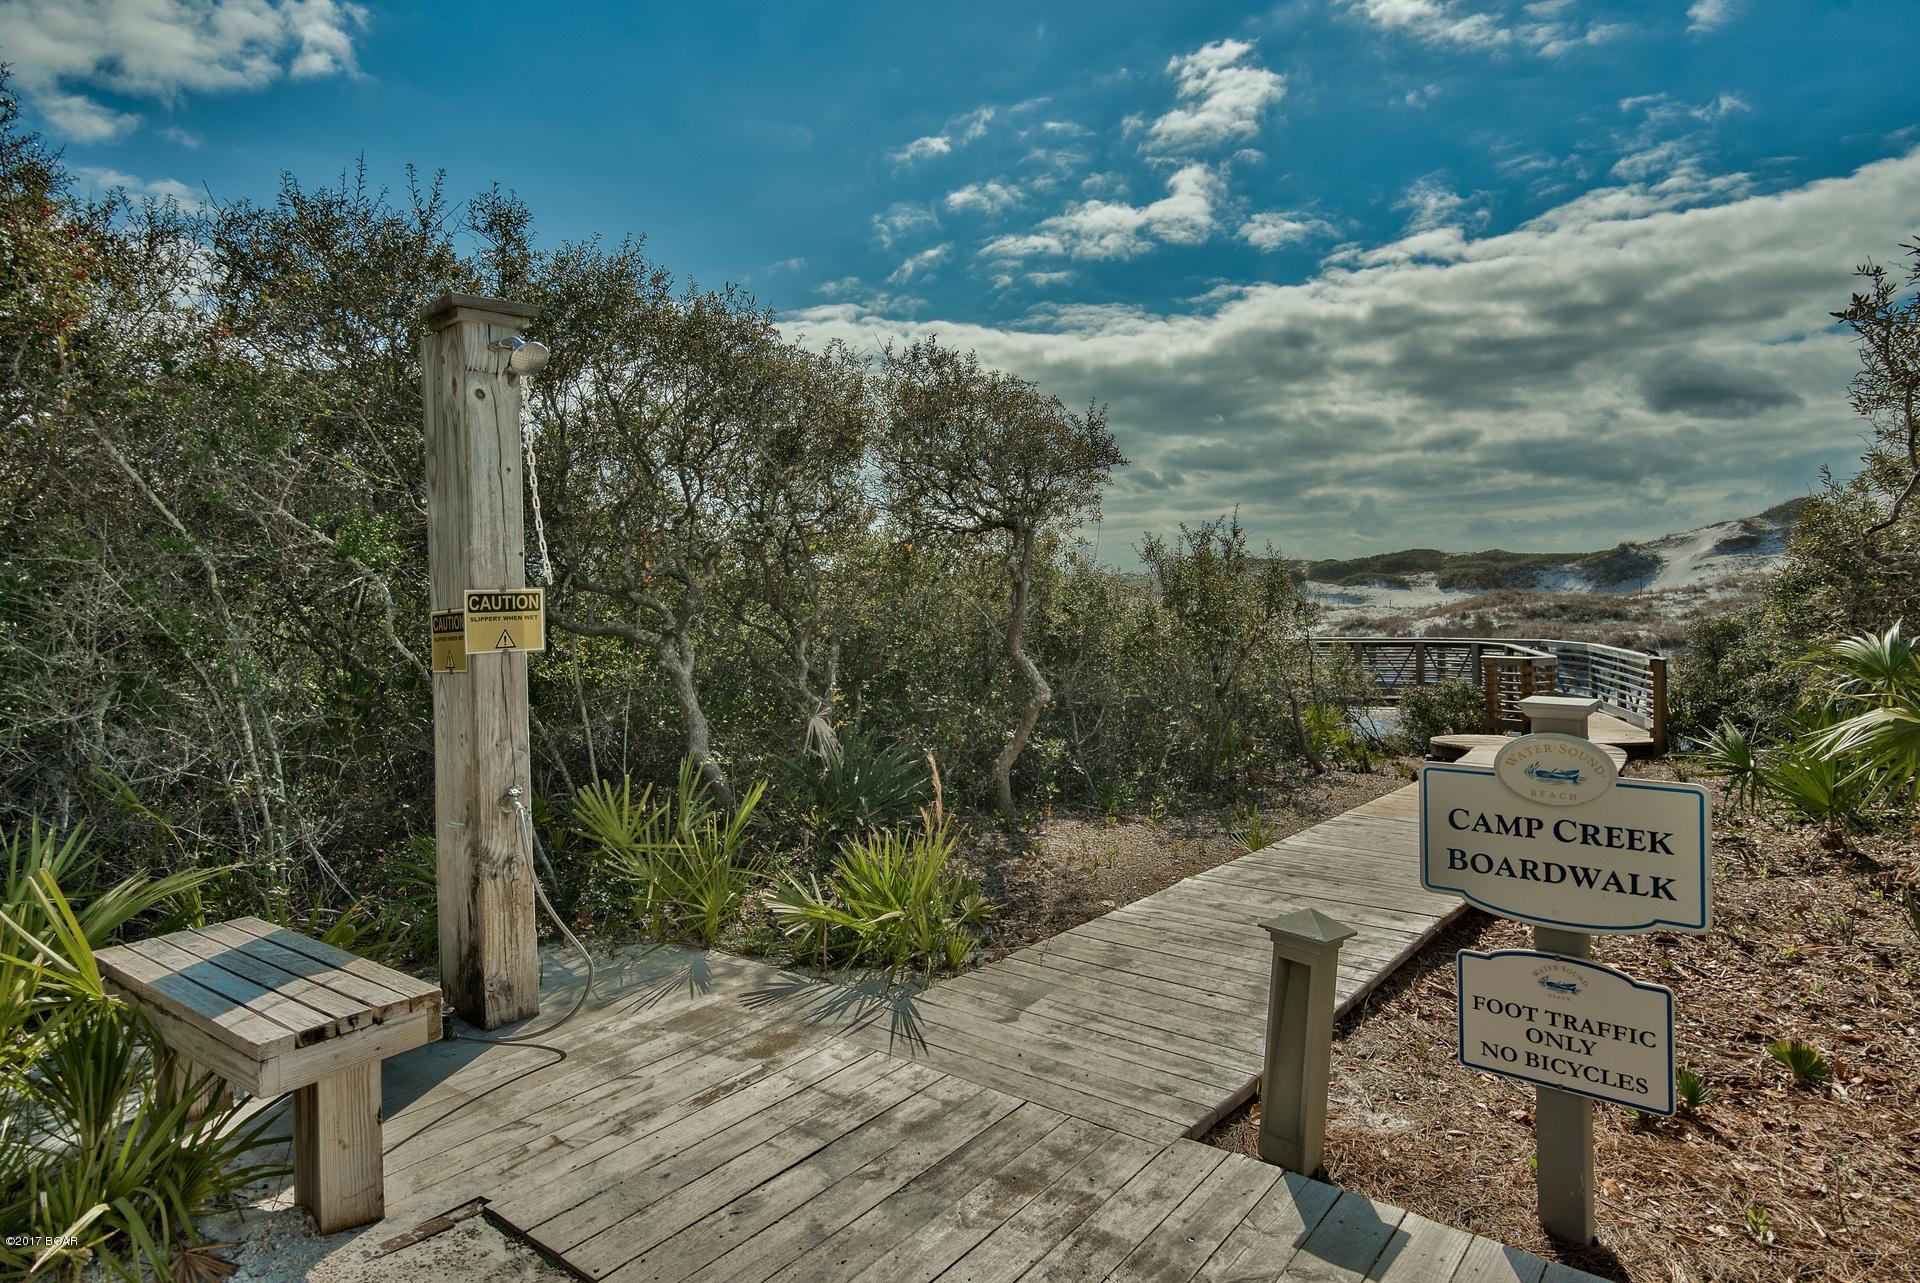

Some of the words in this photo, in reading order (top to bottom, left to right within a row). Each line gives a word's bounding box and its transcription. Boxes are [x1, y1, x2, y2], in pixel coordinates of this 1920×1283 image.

[468, 594, 539, 610] CAUTION
[1530, 789, 1577, 800] BEACH
[1448, 808, 1544, 839] CAMP
[1553, 820, 1675, 856] CREEK
[1446, 848, 1678, 901] BOARDWALK
[1472, 995, 1538, 1022] FOOT
[1545, 1010, 1656, 1048] TRAFFIC
[1526, 1028, 1598, 1056] ONLY
[1480, 1040, 1518, 1062] NO
[1525, 1051, 1648, 1094] BICYCLES
